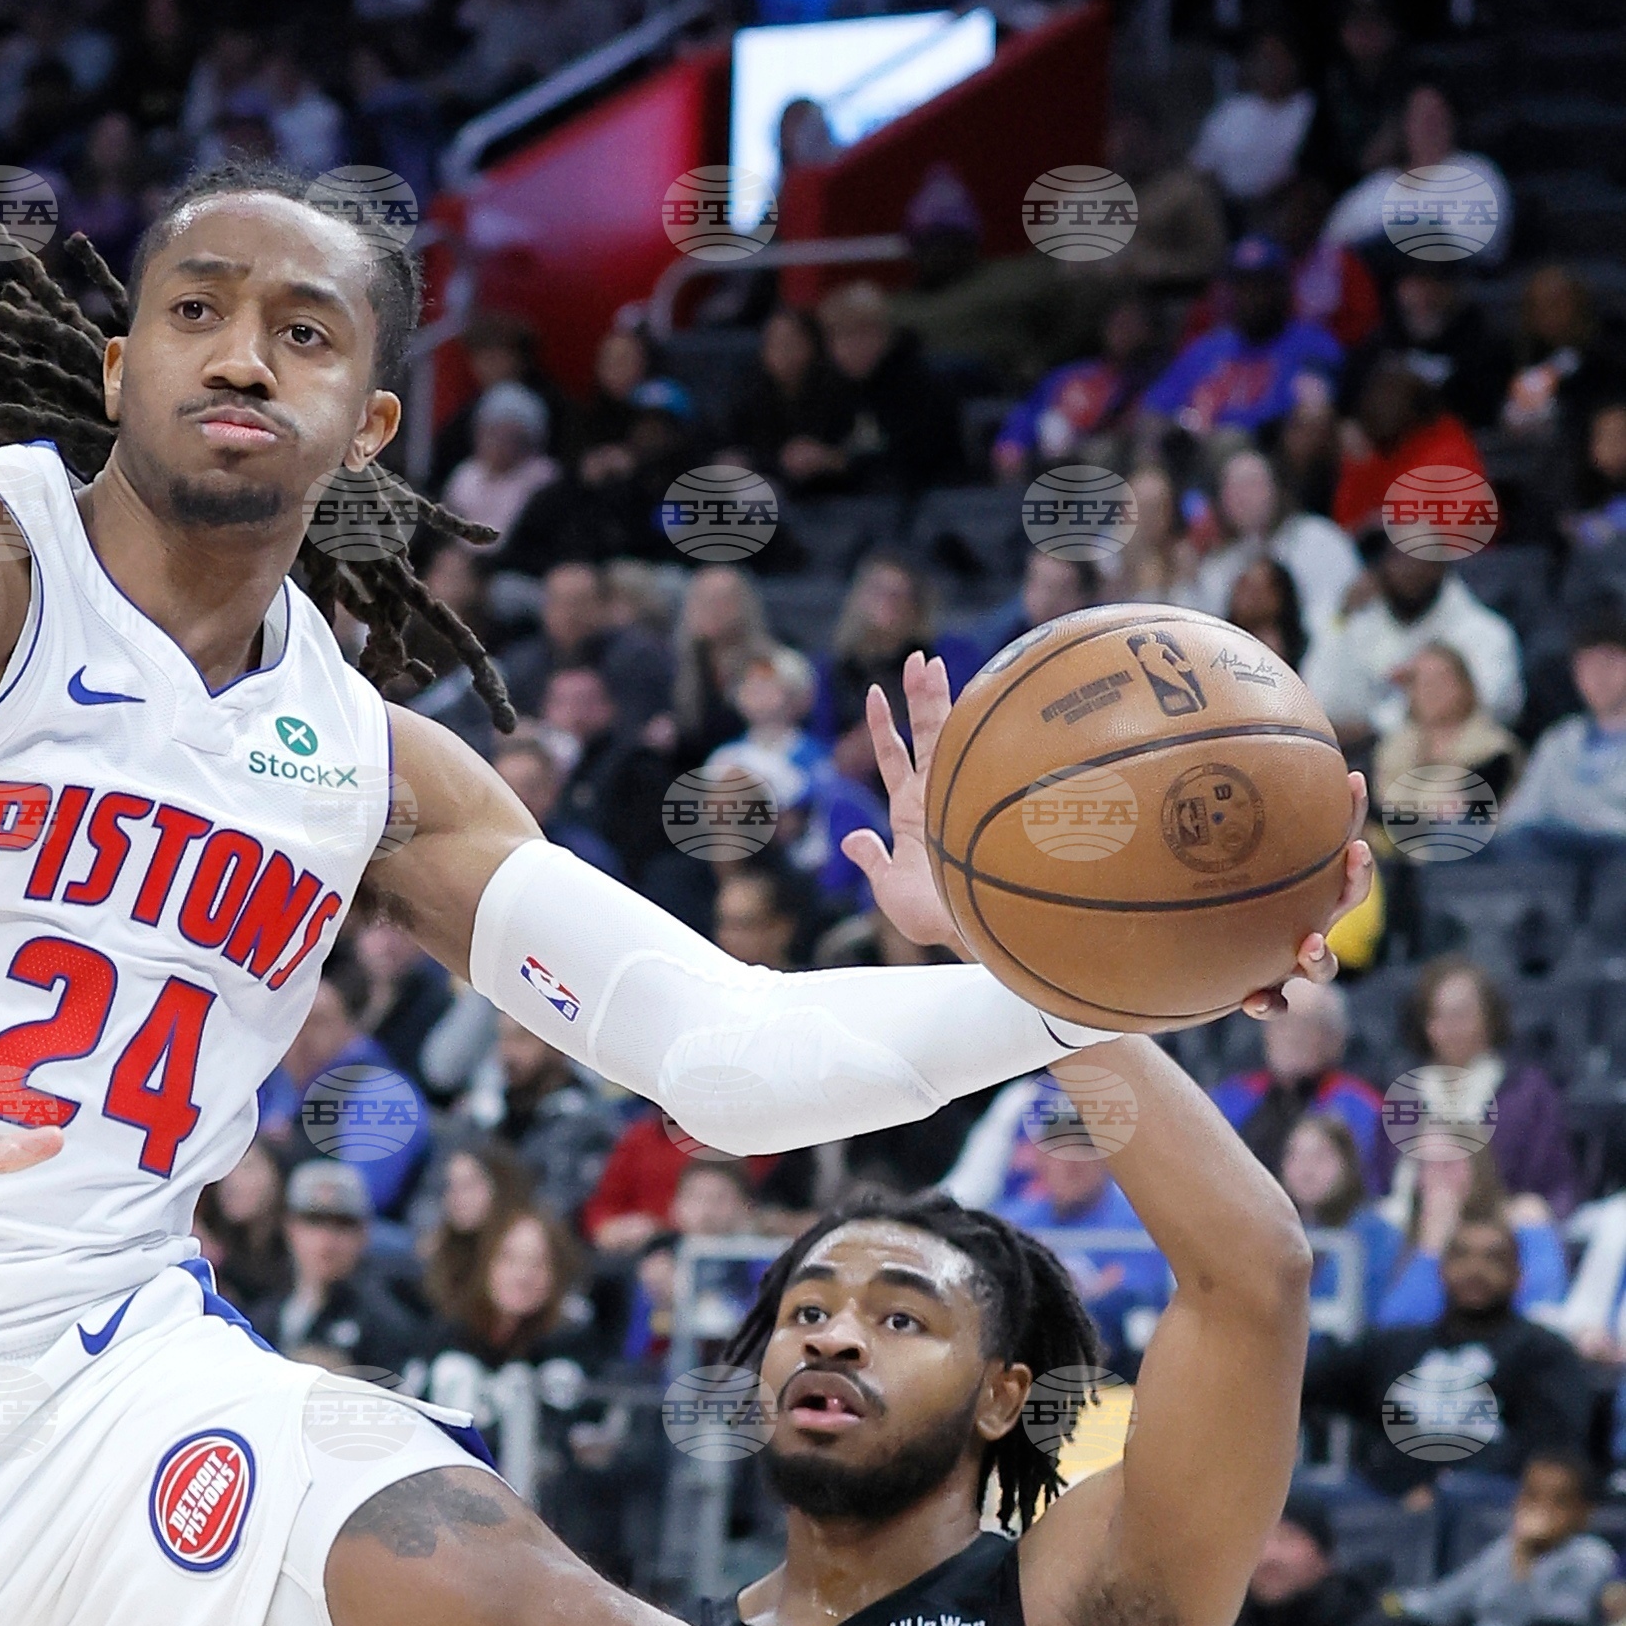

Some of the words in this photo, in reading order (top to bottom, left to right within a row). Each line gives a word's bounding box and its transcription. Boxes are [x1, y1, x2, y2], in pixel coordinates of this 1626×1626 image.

[248, 750, 359, 789] StockX
[168, 1450, 224, 1533] DETROIT
[181, 1462, 236, 1548] PISTONS
